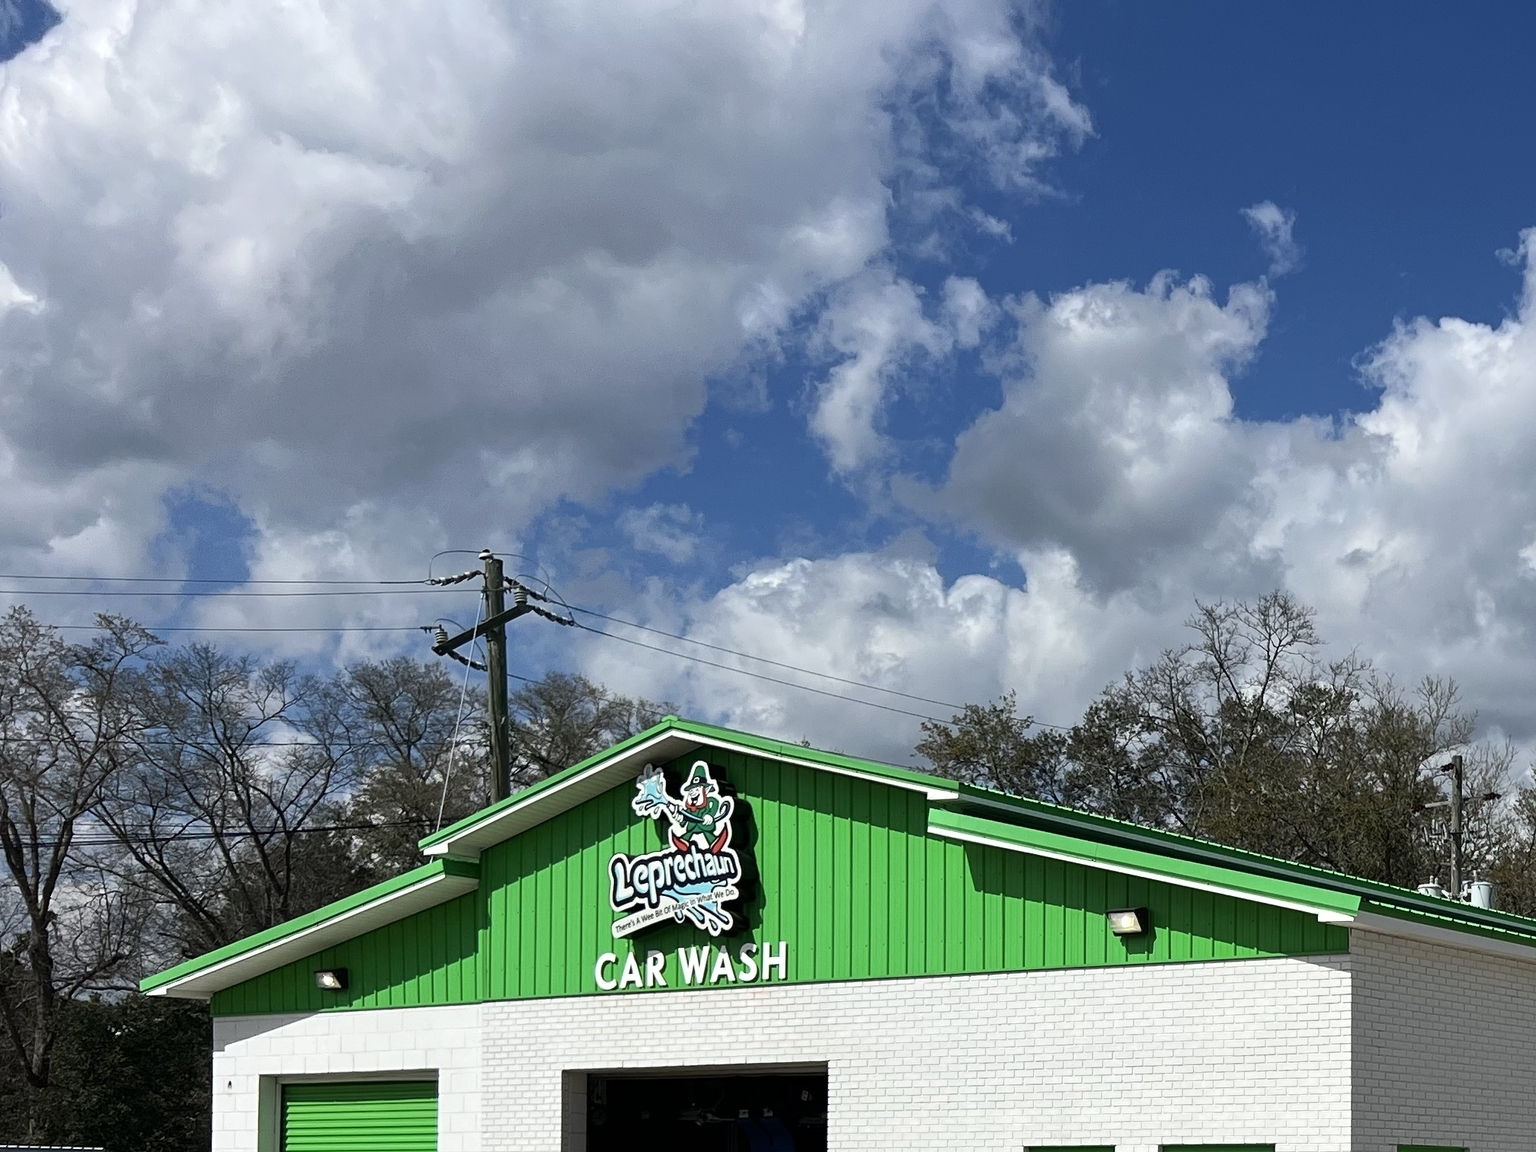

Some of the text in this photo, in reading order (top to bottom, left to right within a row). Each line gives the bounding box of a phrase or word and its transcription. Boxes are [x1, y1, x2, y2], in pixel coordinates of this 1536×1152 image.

[614, 845, 736, 904] Leprechaun
[616, 888, 735, 932] There's A Wee Bit Of Magic In What We Do.
[595, 941, 786, 990] CAR WASH
